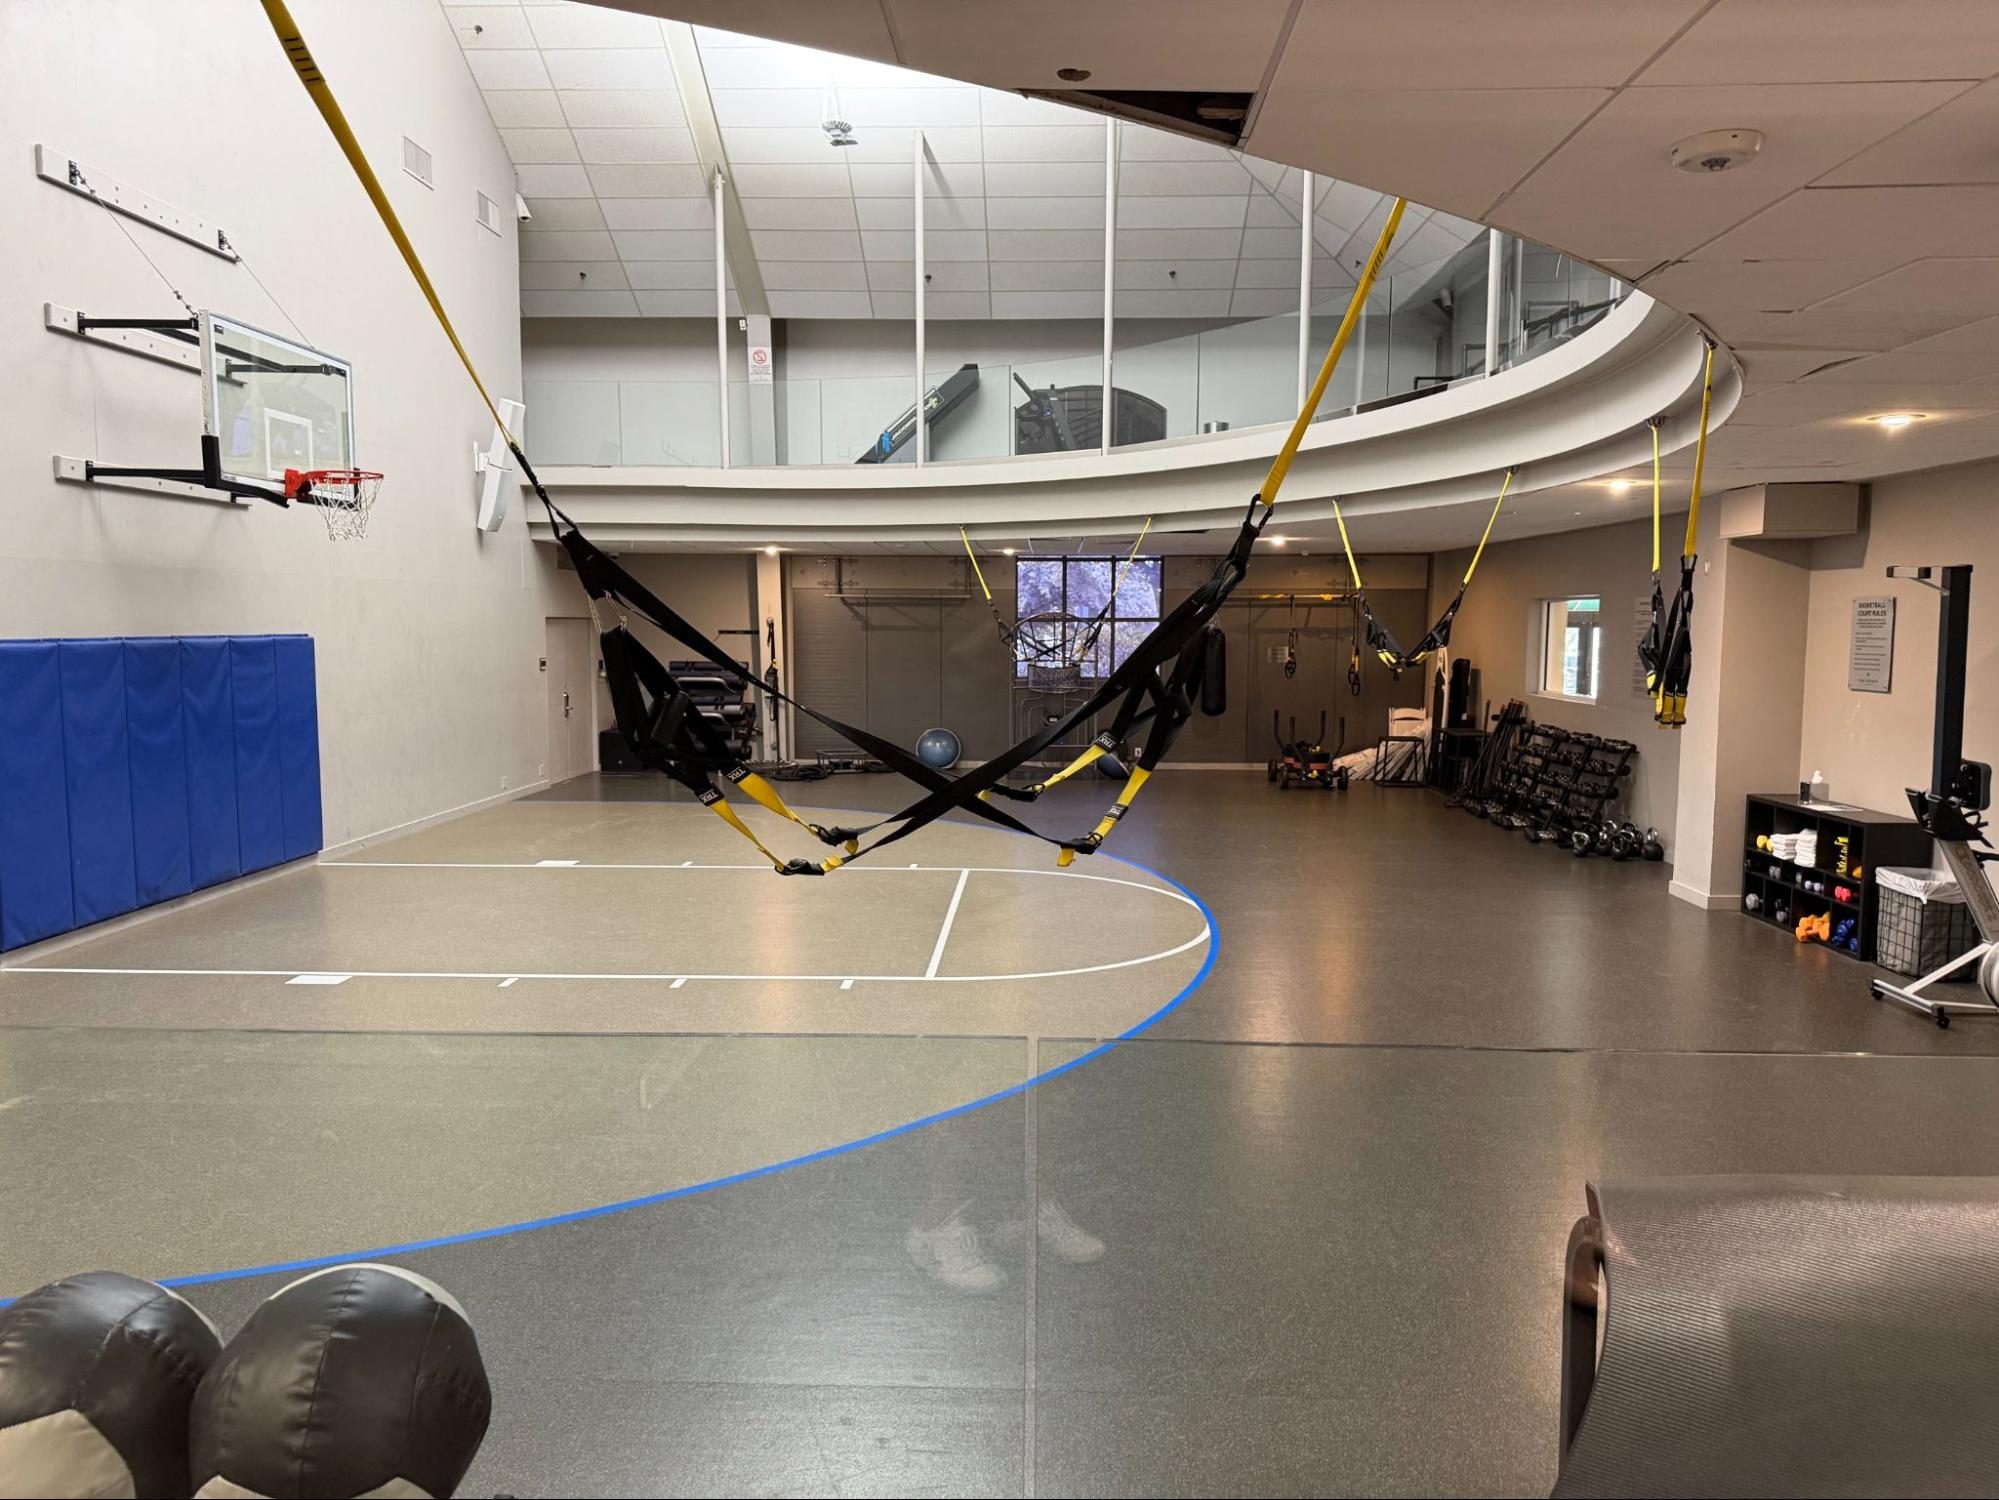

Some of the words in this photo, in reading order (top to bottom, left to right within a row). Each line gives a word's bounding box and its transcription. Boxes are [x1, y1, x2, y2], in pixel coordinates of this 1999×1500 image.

[1098, 737, 1114, 749] TRX
[727, 768, 746, 782] TRX
[700, 790, 719, 803] TRX
